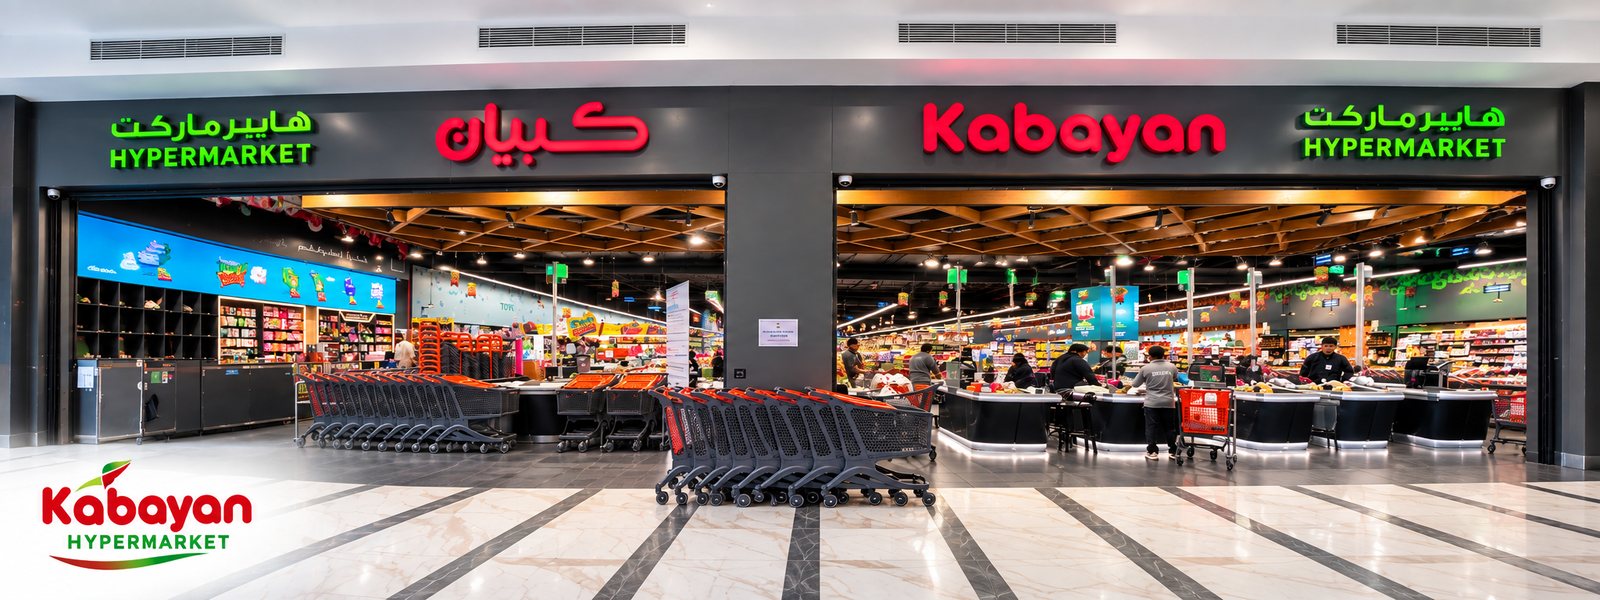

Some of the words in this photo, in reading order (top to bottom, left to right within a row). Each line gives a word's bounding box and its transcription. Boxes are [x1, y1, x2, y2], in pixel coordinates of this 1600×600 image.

[435, 101, 649, 166] كبيان
[923, 102, 1227, 163] Kabayan
[1304, 137, 1506, 157] HYPERMARKET
[110, 143, 311, 168] HYPERMARKET
